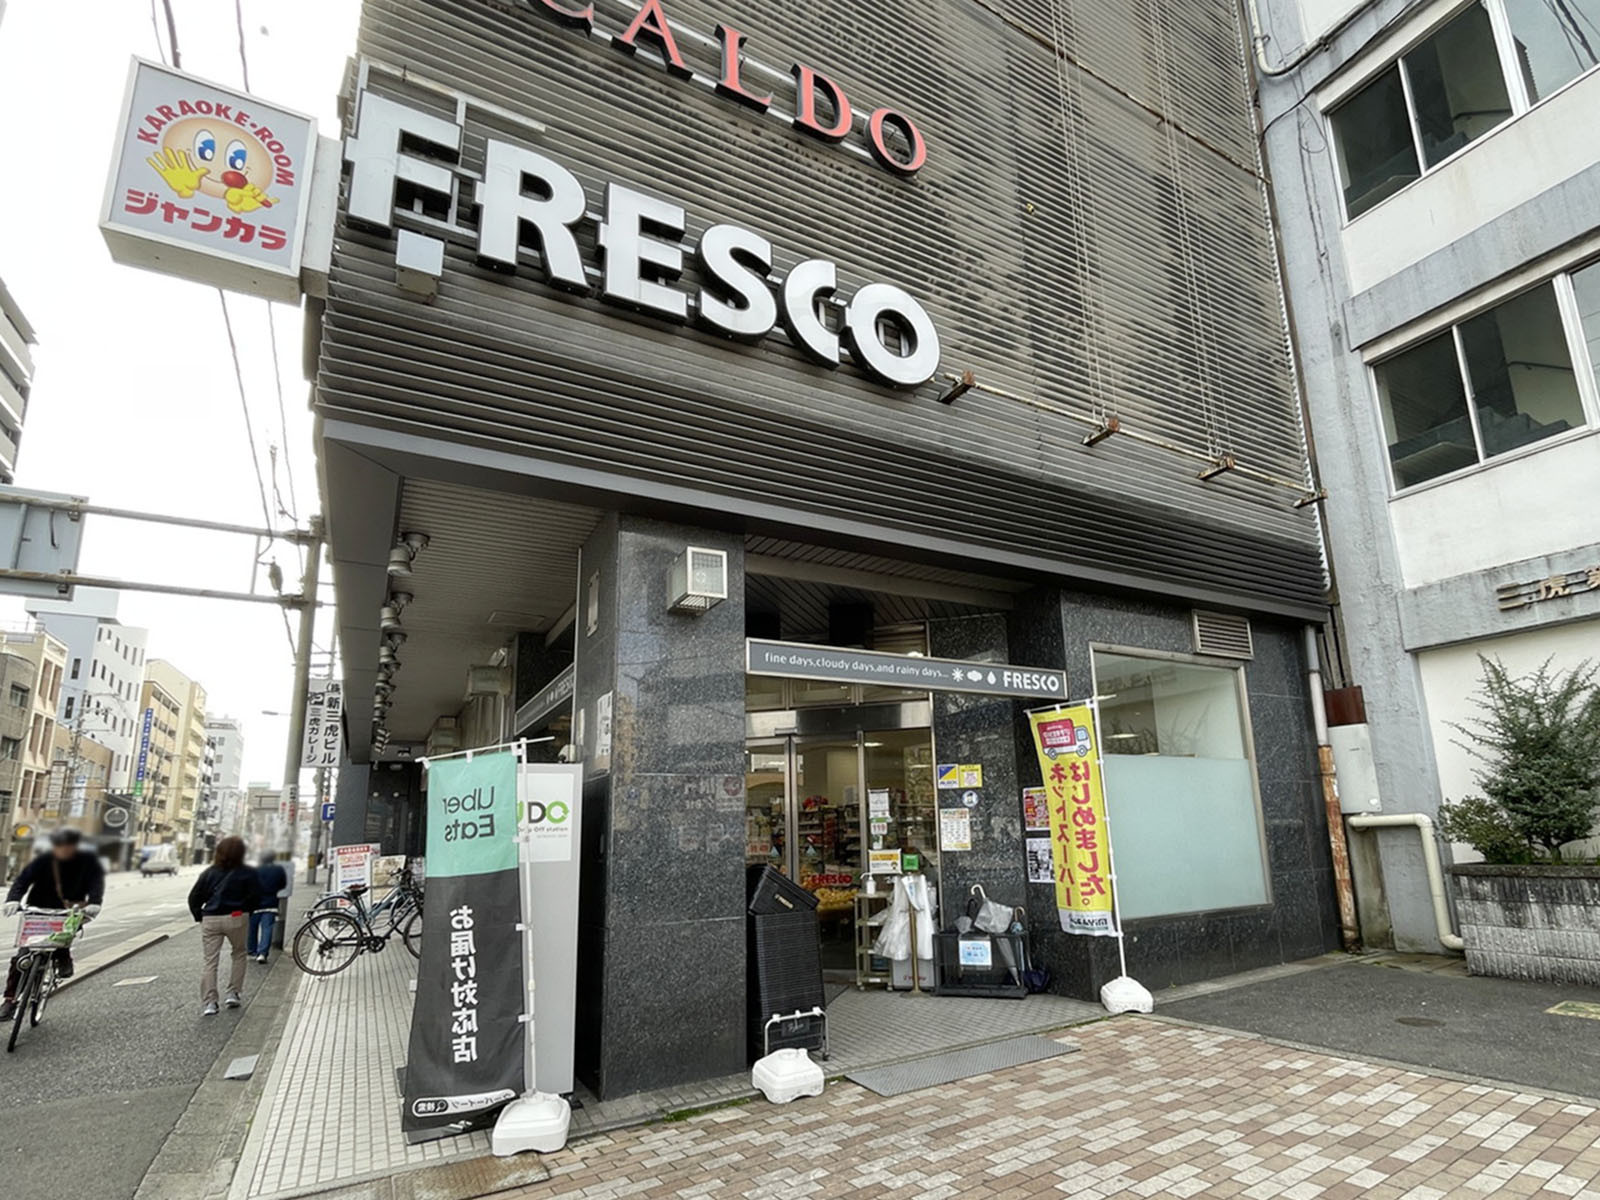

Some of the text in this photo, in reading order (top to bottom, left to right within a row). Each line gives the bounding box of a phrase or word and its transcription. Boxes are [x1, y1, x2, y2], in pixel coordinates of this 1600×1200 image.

[124, 188, 288, 251] ジャンカラ
[345, 90, 941, 387] FRESCO
[765, 652, 787, 664] fine
[896, 664, 920, 677] rainy
[1003, 671, 1060, 692] FRESCO
